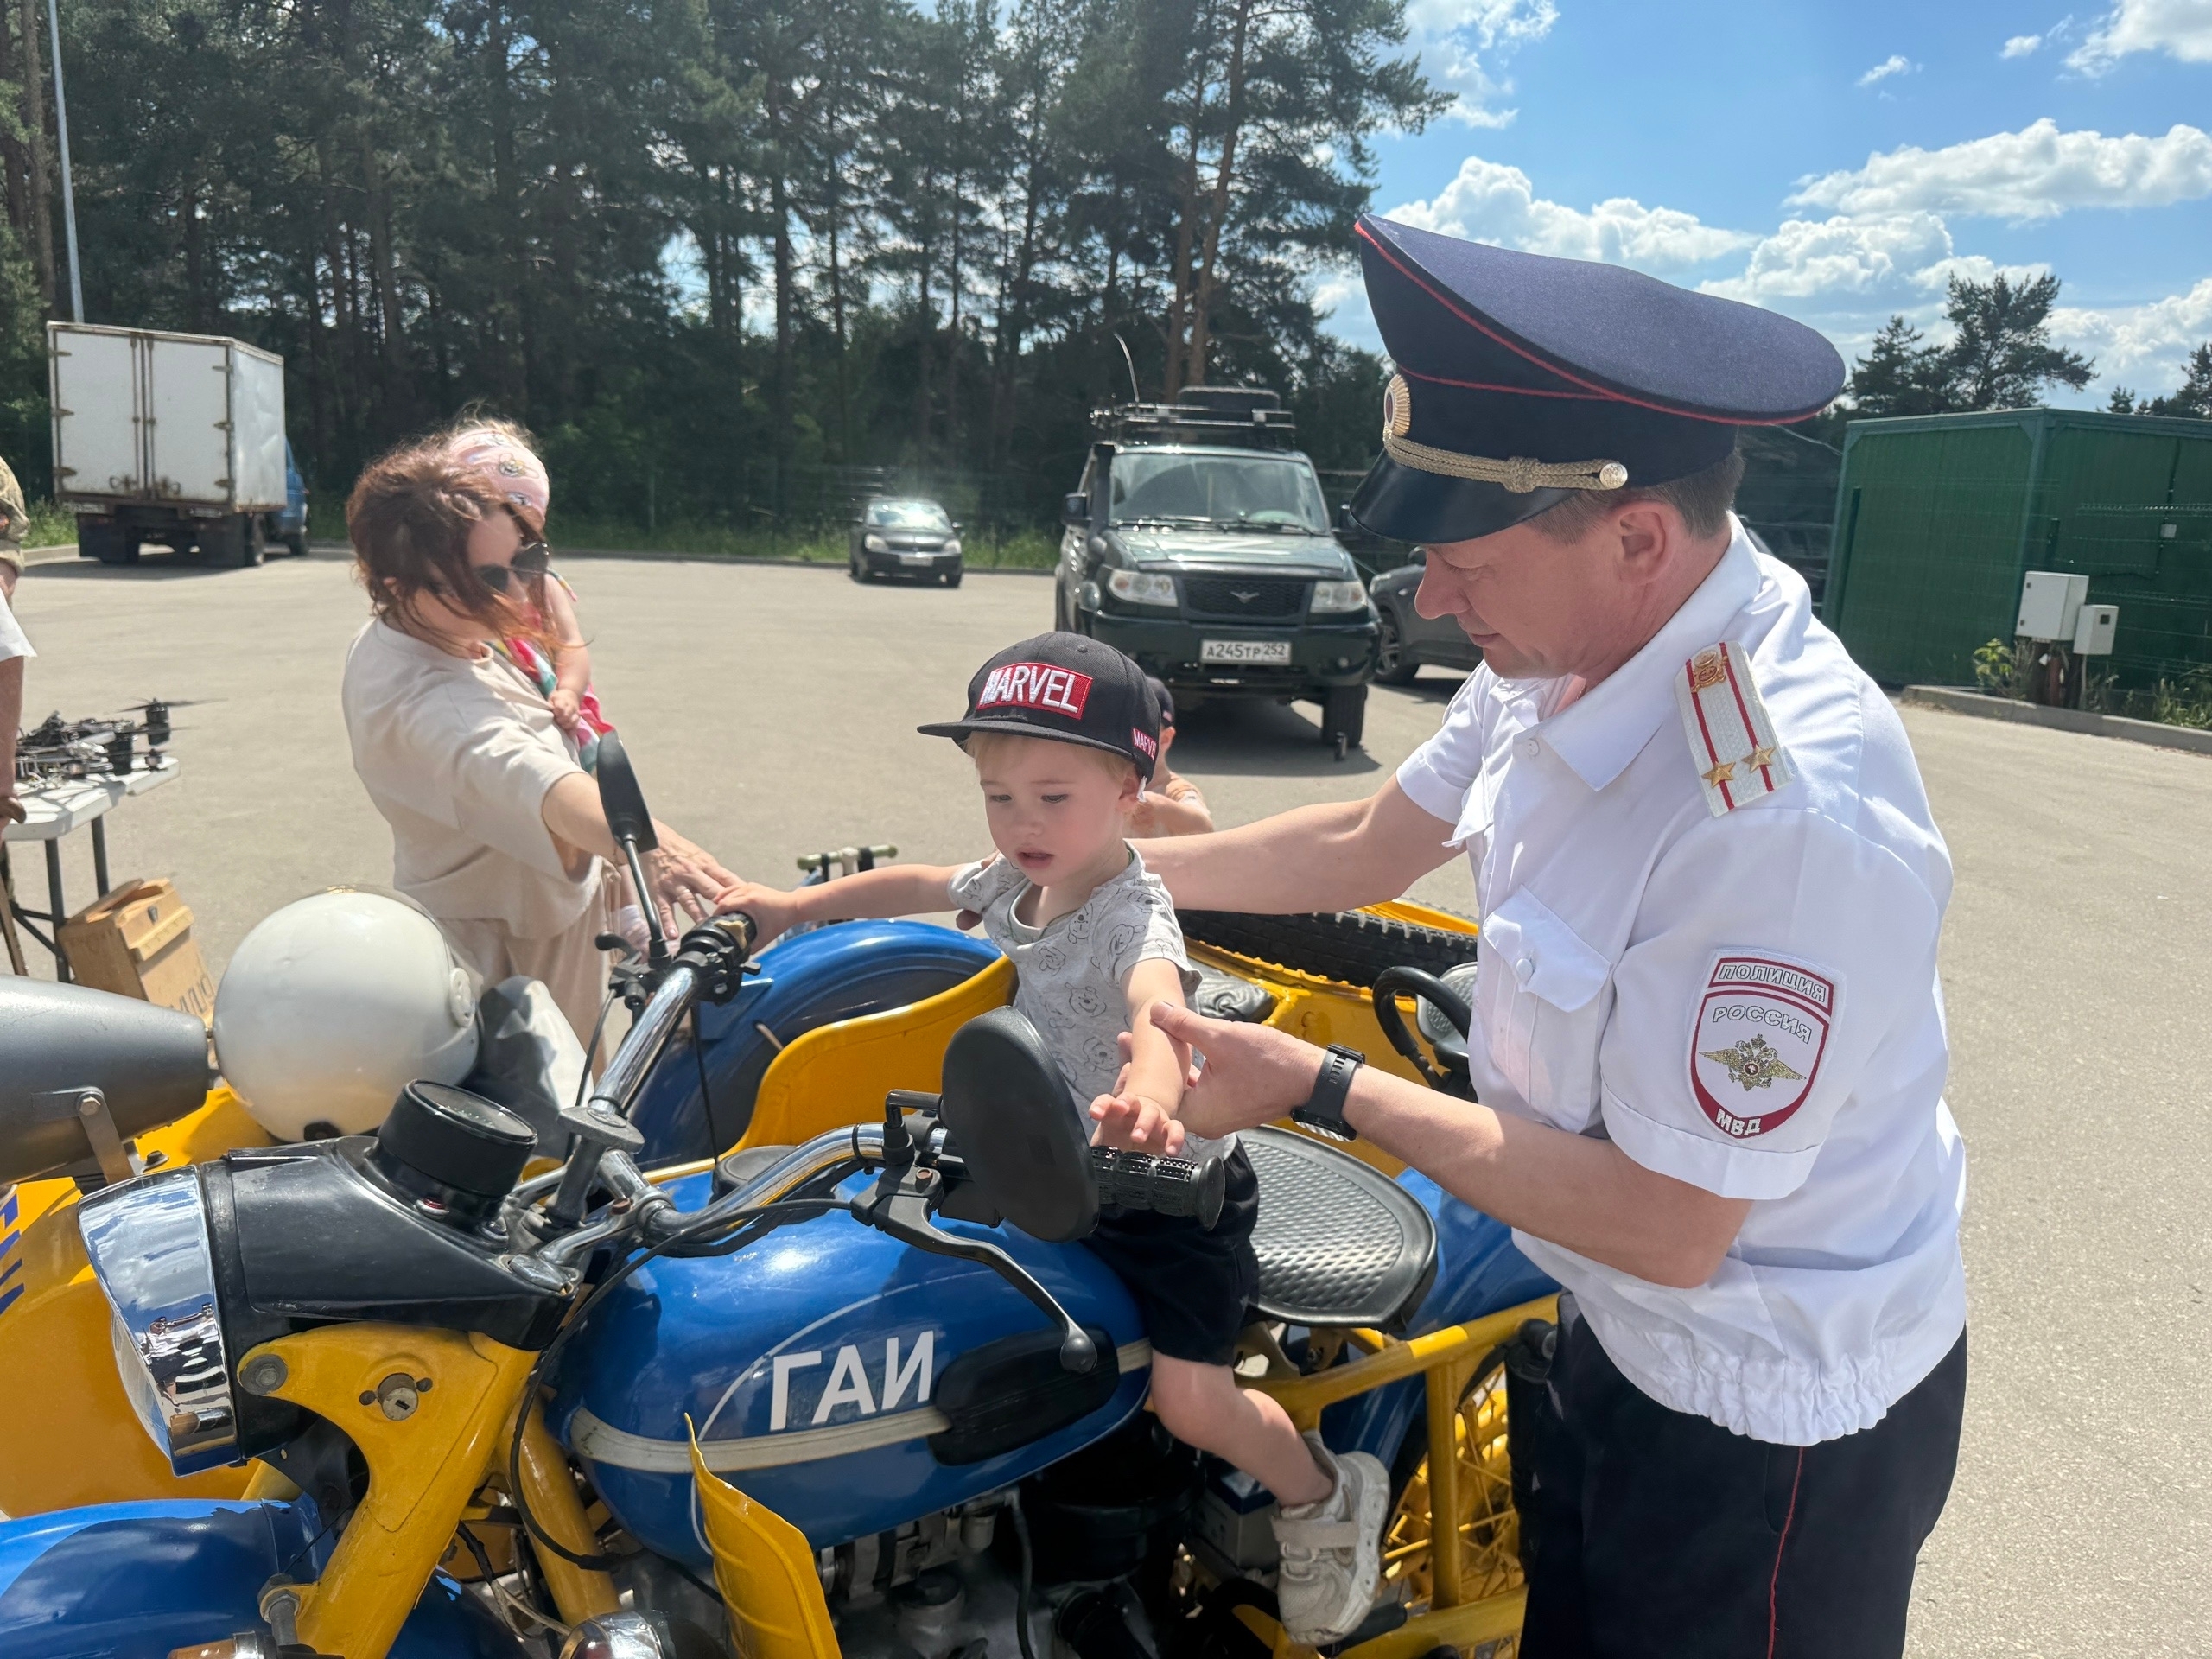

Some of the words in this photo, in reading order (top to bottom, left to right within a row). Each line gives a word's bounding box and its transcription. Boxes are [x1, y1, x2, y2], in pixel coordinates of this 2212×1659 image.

[1263, 644, 1286, 657] 252
[979, 665, 1078, 714] MARVEL
[1718, 964, 1827, 1002] ПОЛИЦИЯ
[1712, 1004, 1813, 1045] РОССИЯ
[1715, 1108, 1761, 1136] МВД
[770, 1330, 934, 1432] ГАИ
